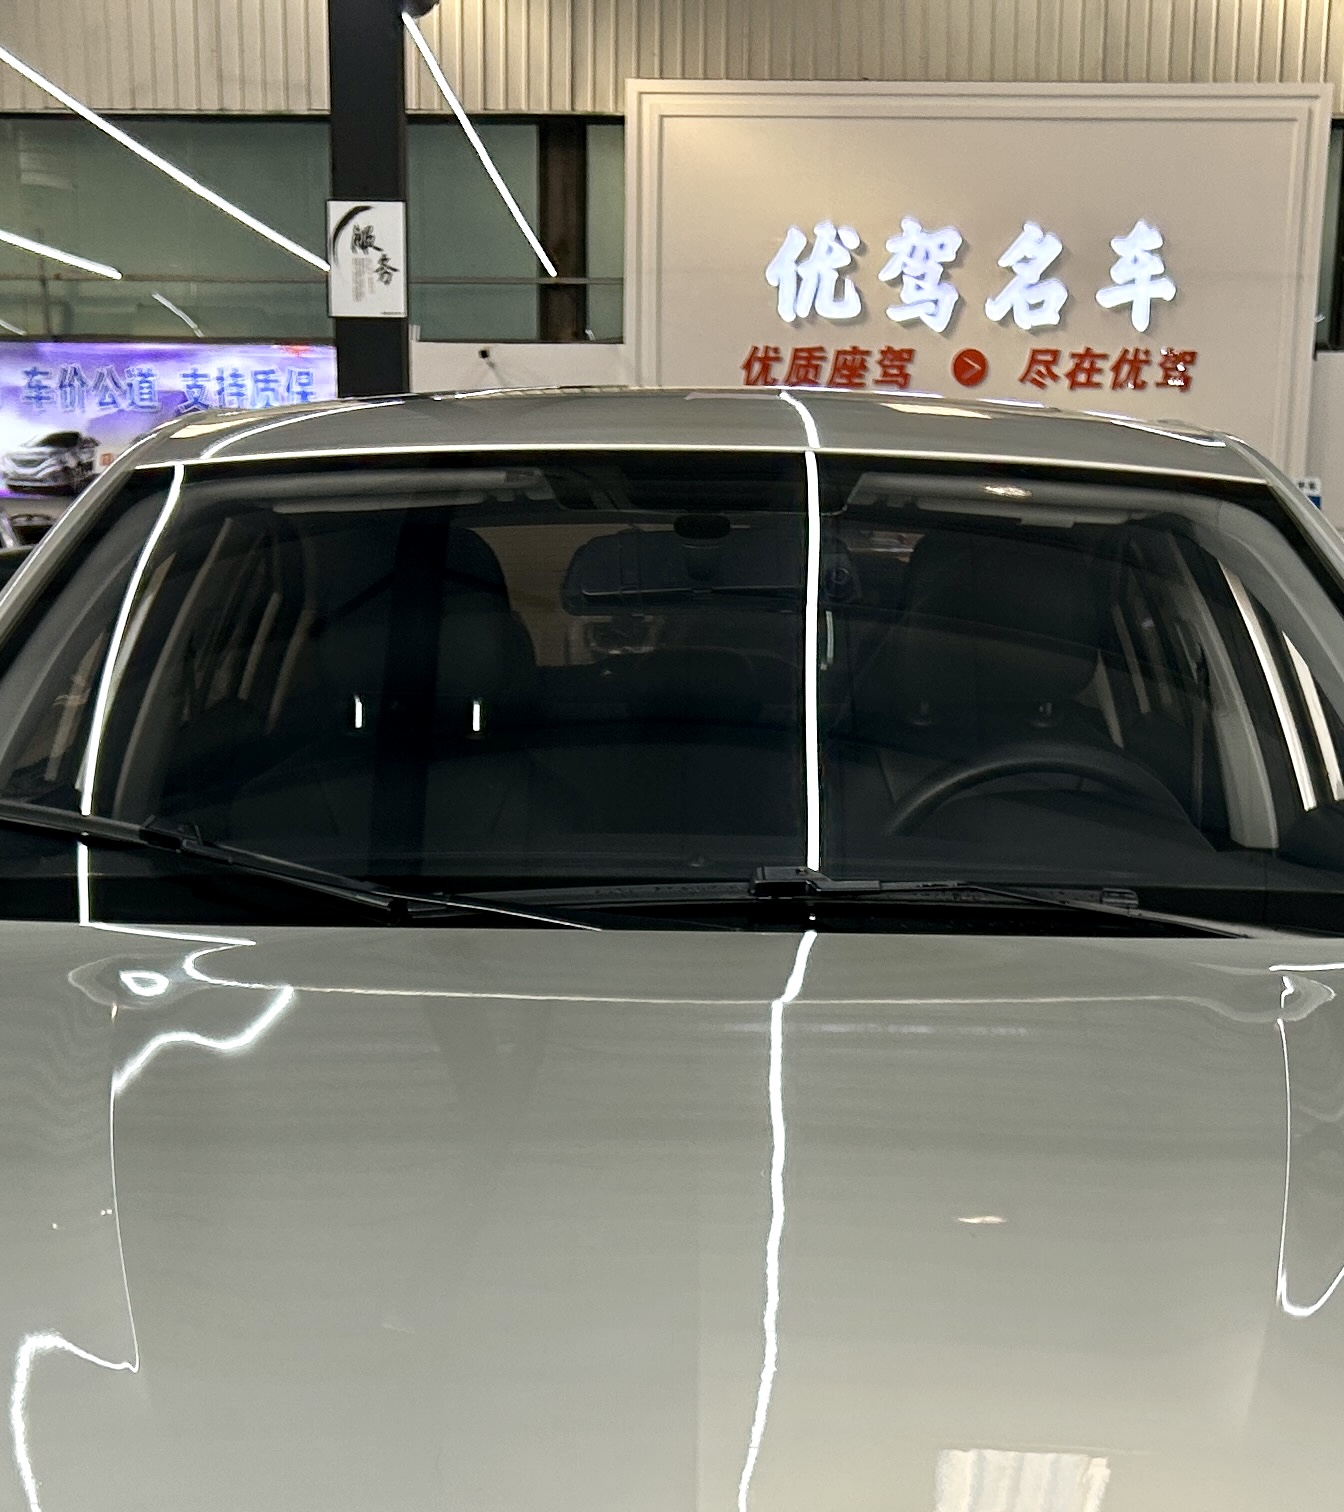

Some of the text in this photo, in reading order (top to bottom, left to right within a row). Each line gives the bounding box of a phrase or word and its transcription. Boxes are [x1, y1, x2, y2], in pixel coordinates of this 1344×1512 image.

[765, 216, 1177, 333] 优驾名车
[22, 363, 160, 412] 车价公道
[740, 344, 1198, 393] 优质座驾 尽在优驾
